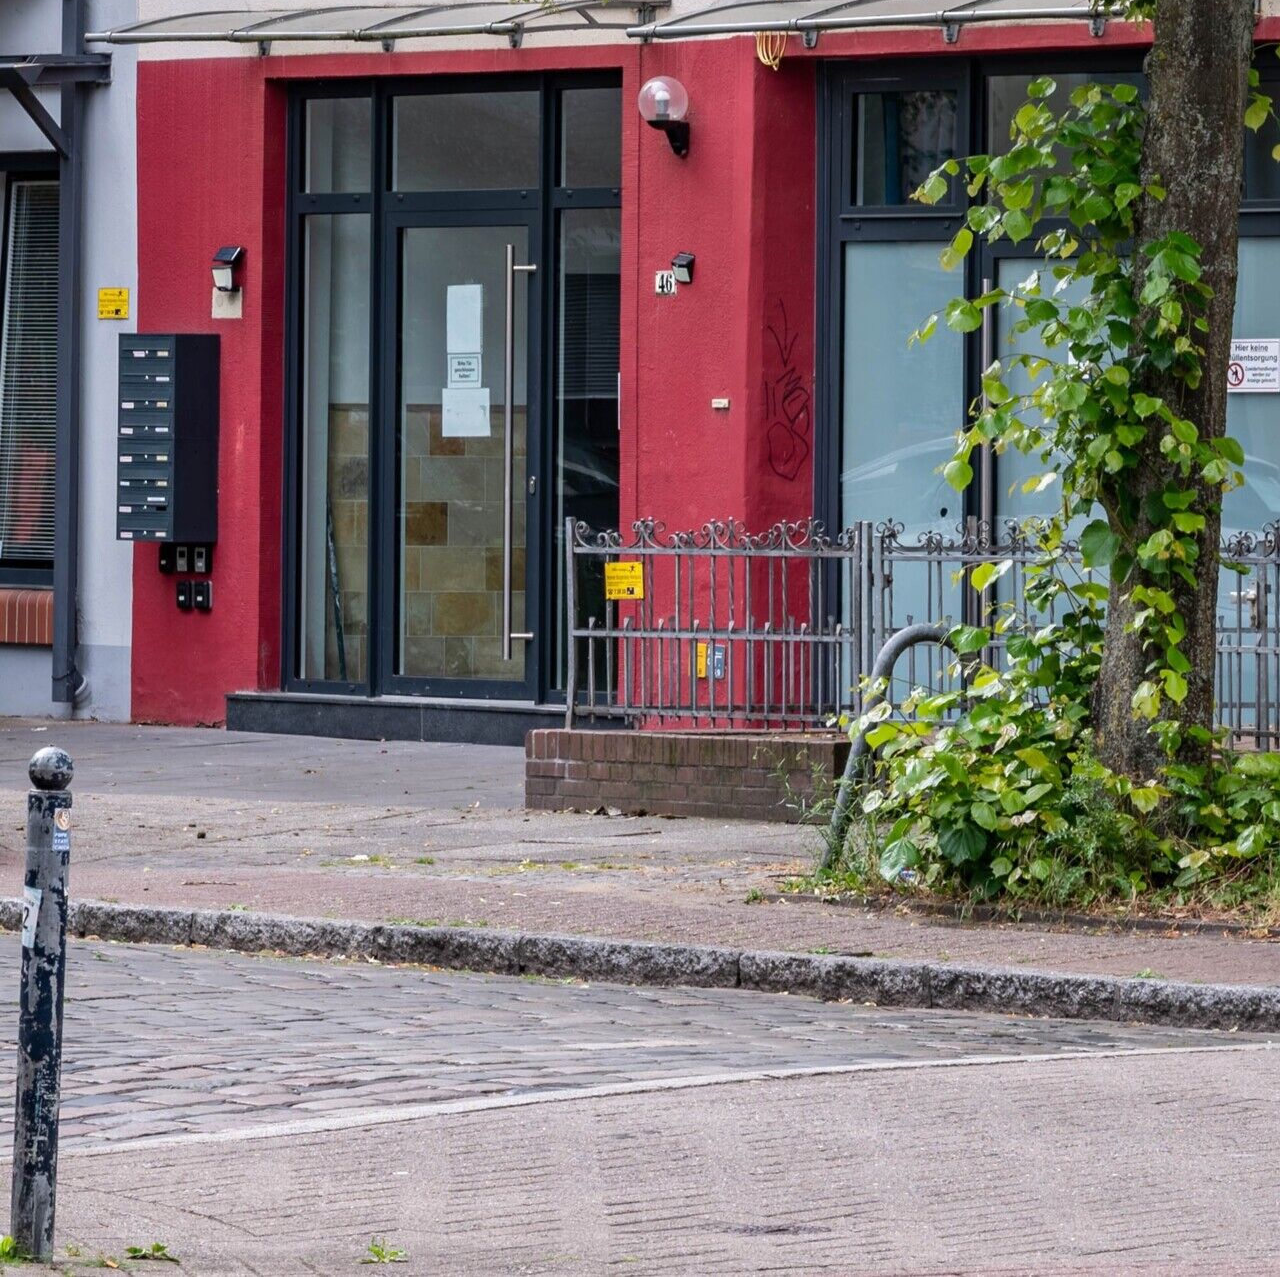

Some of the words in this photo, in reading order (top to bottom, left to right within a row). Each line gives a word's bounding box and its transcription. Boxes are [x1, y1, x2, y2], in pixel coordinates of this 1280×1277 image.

[658, 273, 673, 292] 46
[1251, 343, 1269, 352] keine
[1231, 354, 1278, 363] üllentsorgung
